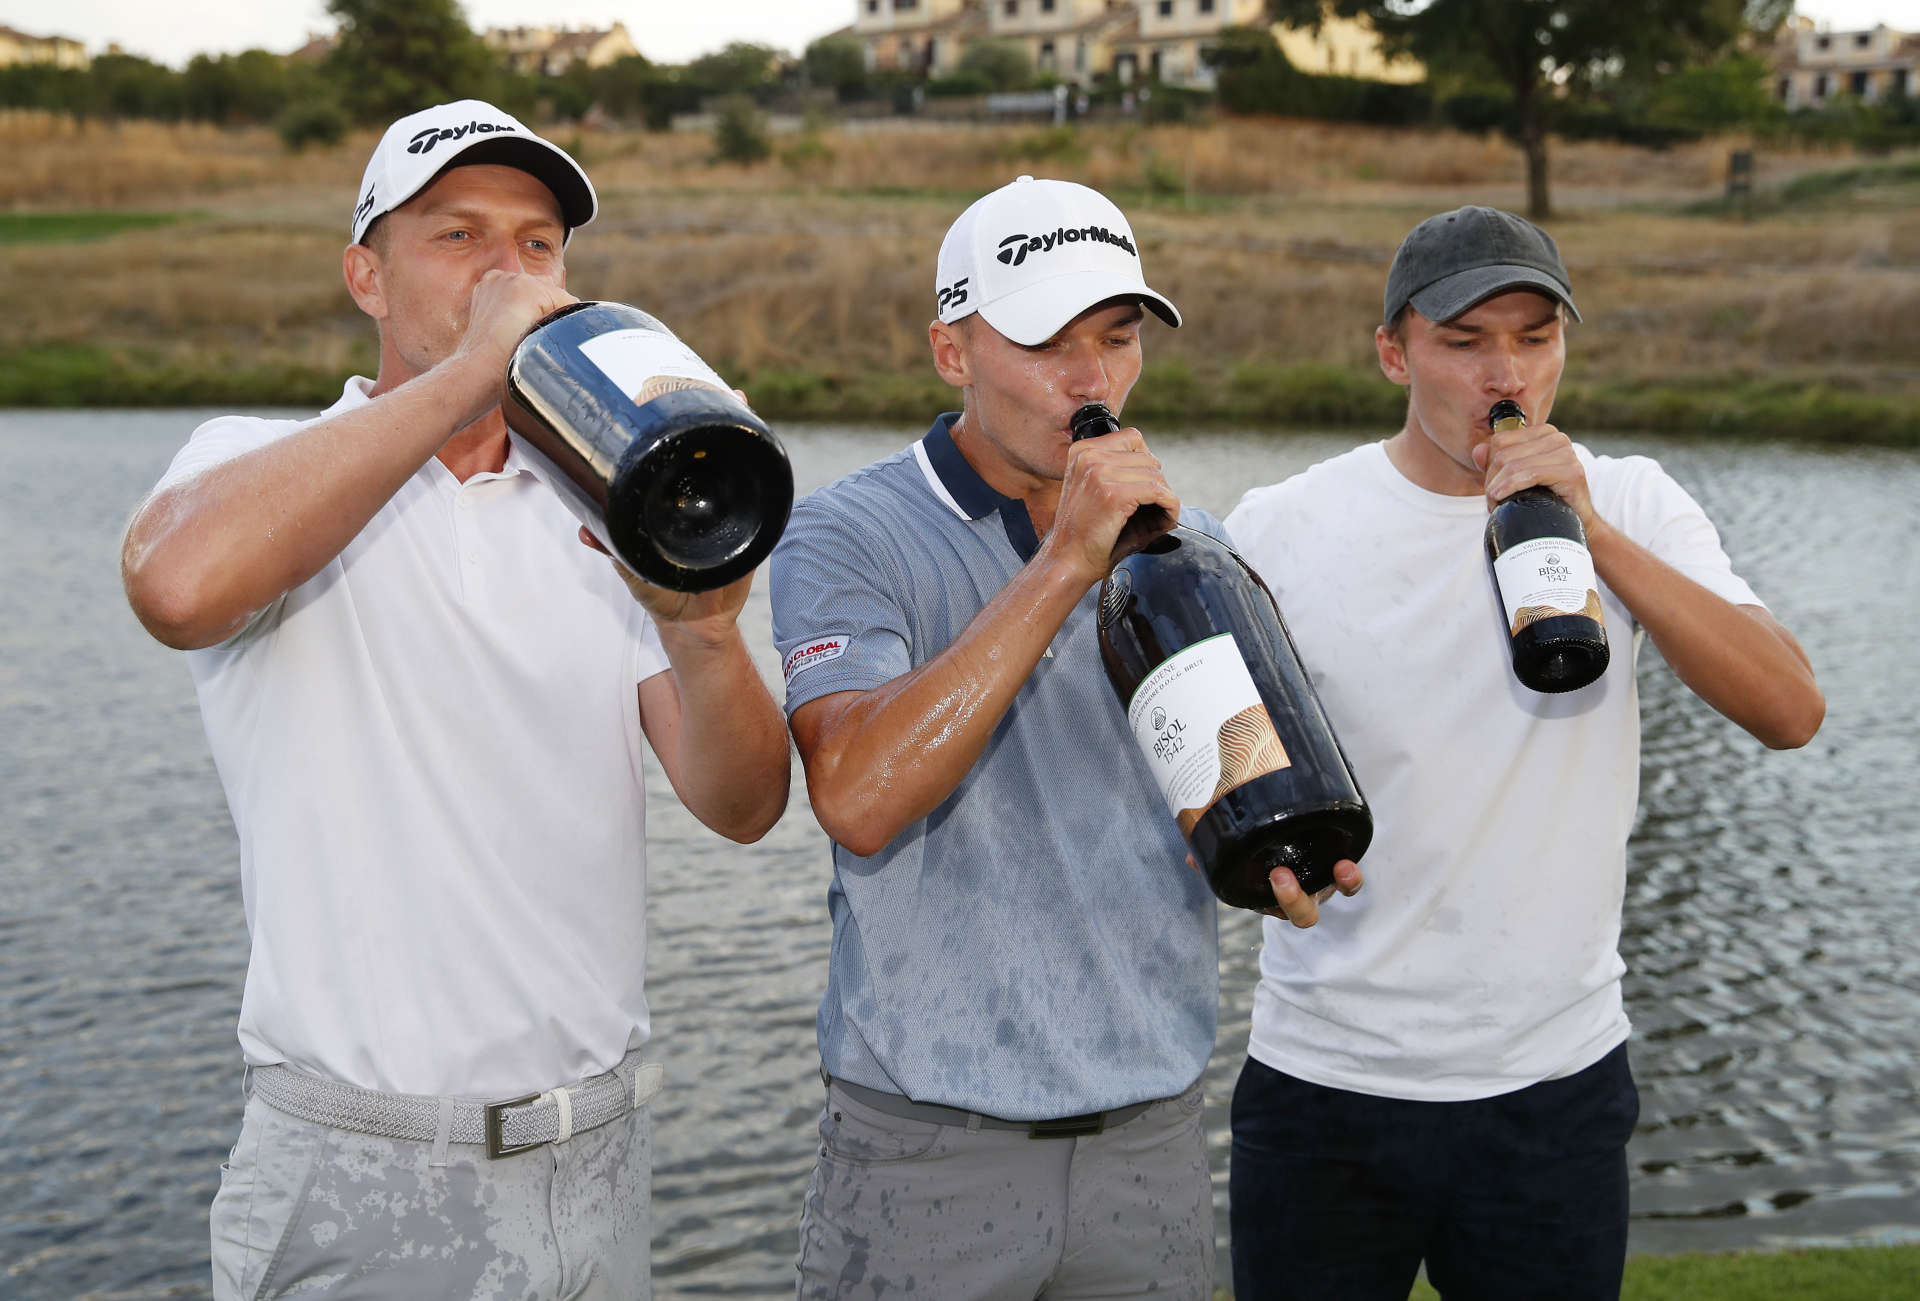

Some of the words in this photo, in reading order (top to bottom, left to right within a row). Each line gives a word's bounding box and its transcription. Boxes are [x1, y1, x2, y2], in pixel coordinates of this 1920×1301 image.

[407, 121, 516, 154] Taylor
[1538, 566, 1572, 576] BISOL
[1547, 575, 1568, 583] 1542
[794, 641, 841, 660] GLOBAL
[1153, 718, 1187, 758] BISOL
[1163, 737, 1185, 765] 1542
